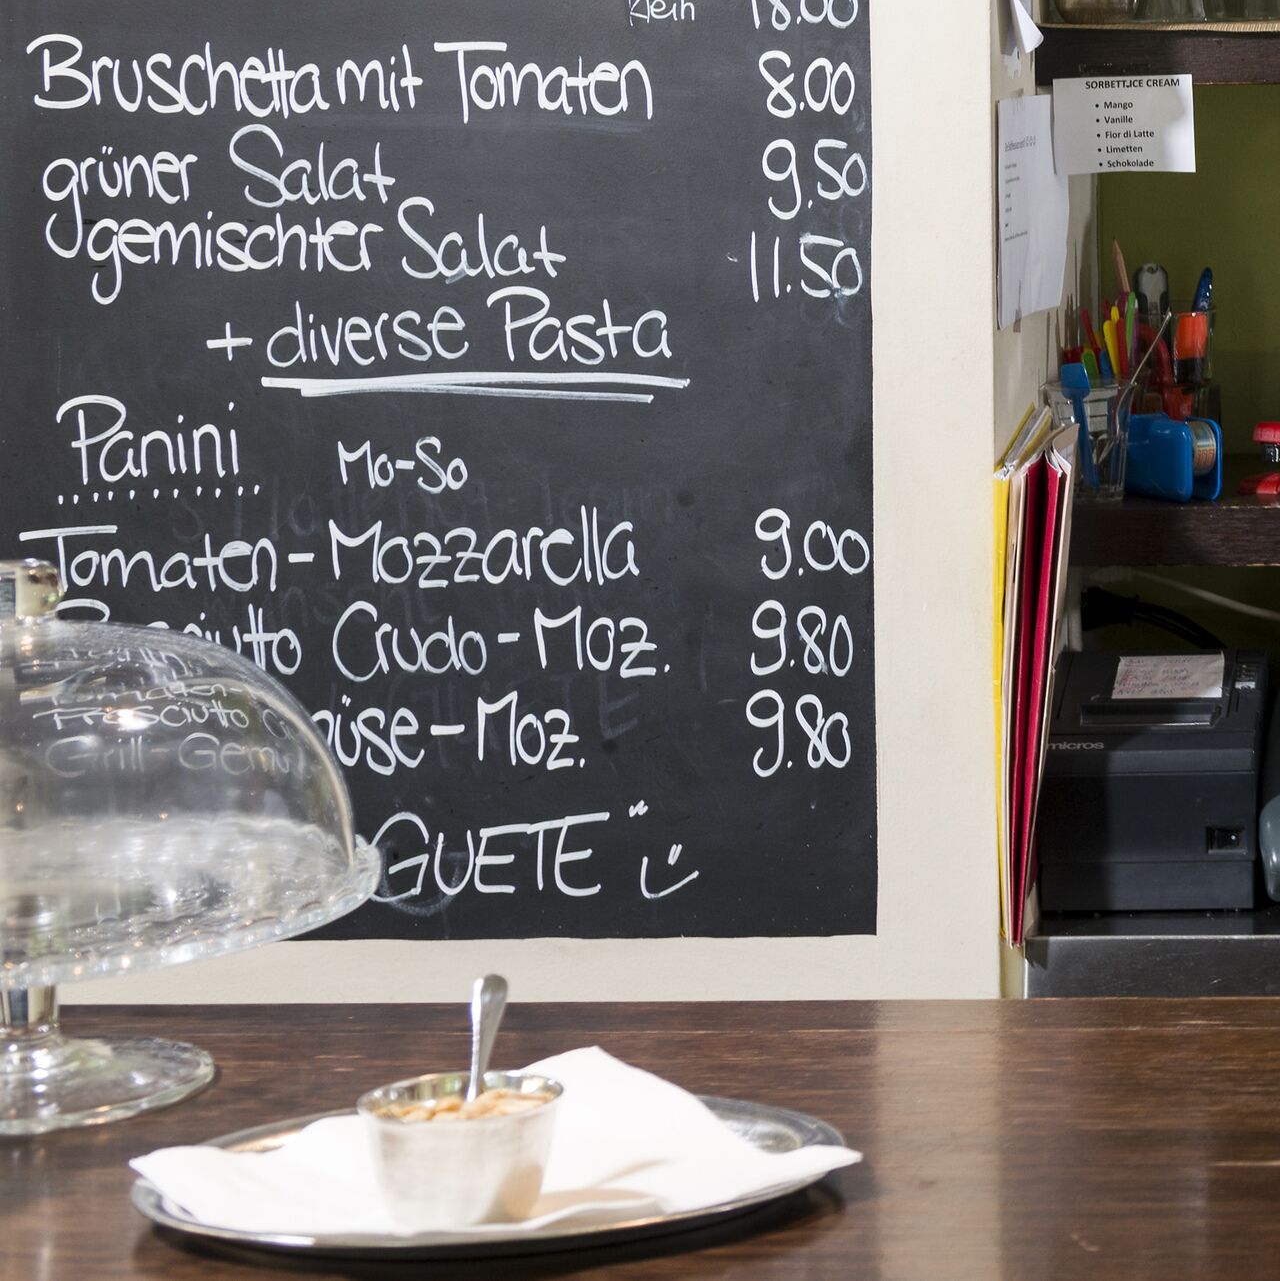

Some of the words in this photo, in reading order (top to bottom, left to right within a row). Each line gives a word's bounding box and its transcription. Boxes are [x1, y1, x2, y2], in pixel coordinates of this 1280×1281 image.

[25, 32, 331, 118] Bruschetta
[335, 44, 423, 117] mit
[432, 40, 655, 125] Tomaten
[757, 49, 856, 118] 8.00
[1103, 101, 1134, 110] Mango
[1146, 78, 1181, 88] CREAM
[1103, 115, 1134, 124] Vanille
[1106, 145, 1143, 153] Limetten
[1123, 130, 1132, 138] di
[1133, 130, 1155, 138] Latte
[42, 143, 199, 260] grüner
[227, 123, 397, 210] Salat
[762, 139, 868, 222] 9.50
[1107, 159, 1155, 168] Schokolade
[85, 209, 385, 307] gemischter
[397, 195, 567, 282] Salat
[748, 231, 863, 305] 11.50
[265, 298, 470, 370] diverse
[487, 286, 673, 369] Pasta
[56, 393, 242, 487] Panini
[337, 435, 470, 494] Mo-So
[753, 505, 872, 582] 9.00
[750, 598, 854, 680] 9.80
[745, 688, 852, 778] 9.80
[372, 810, 610, 902] GUETE
